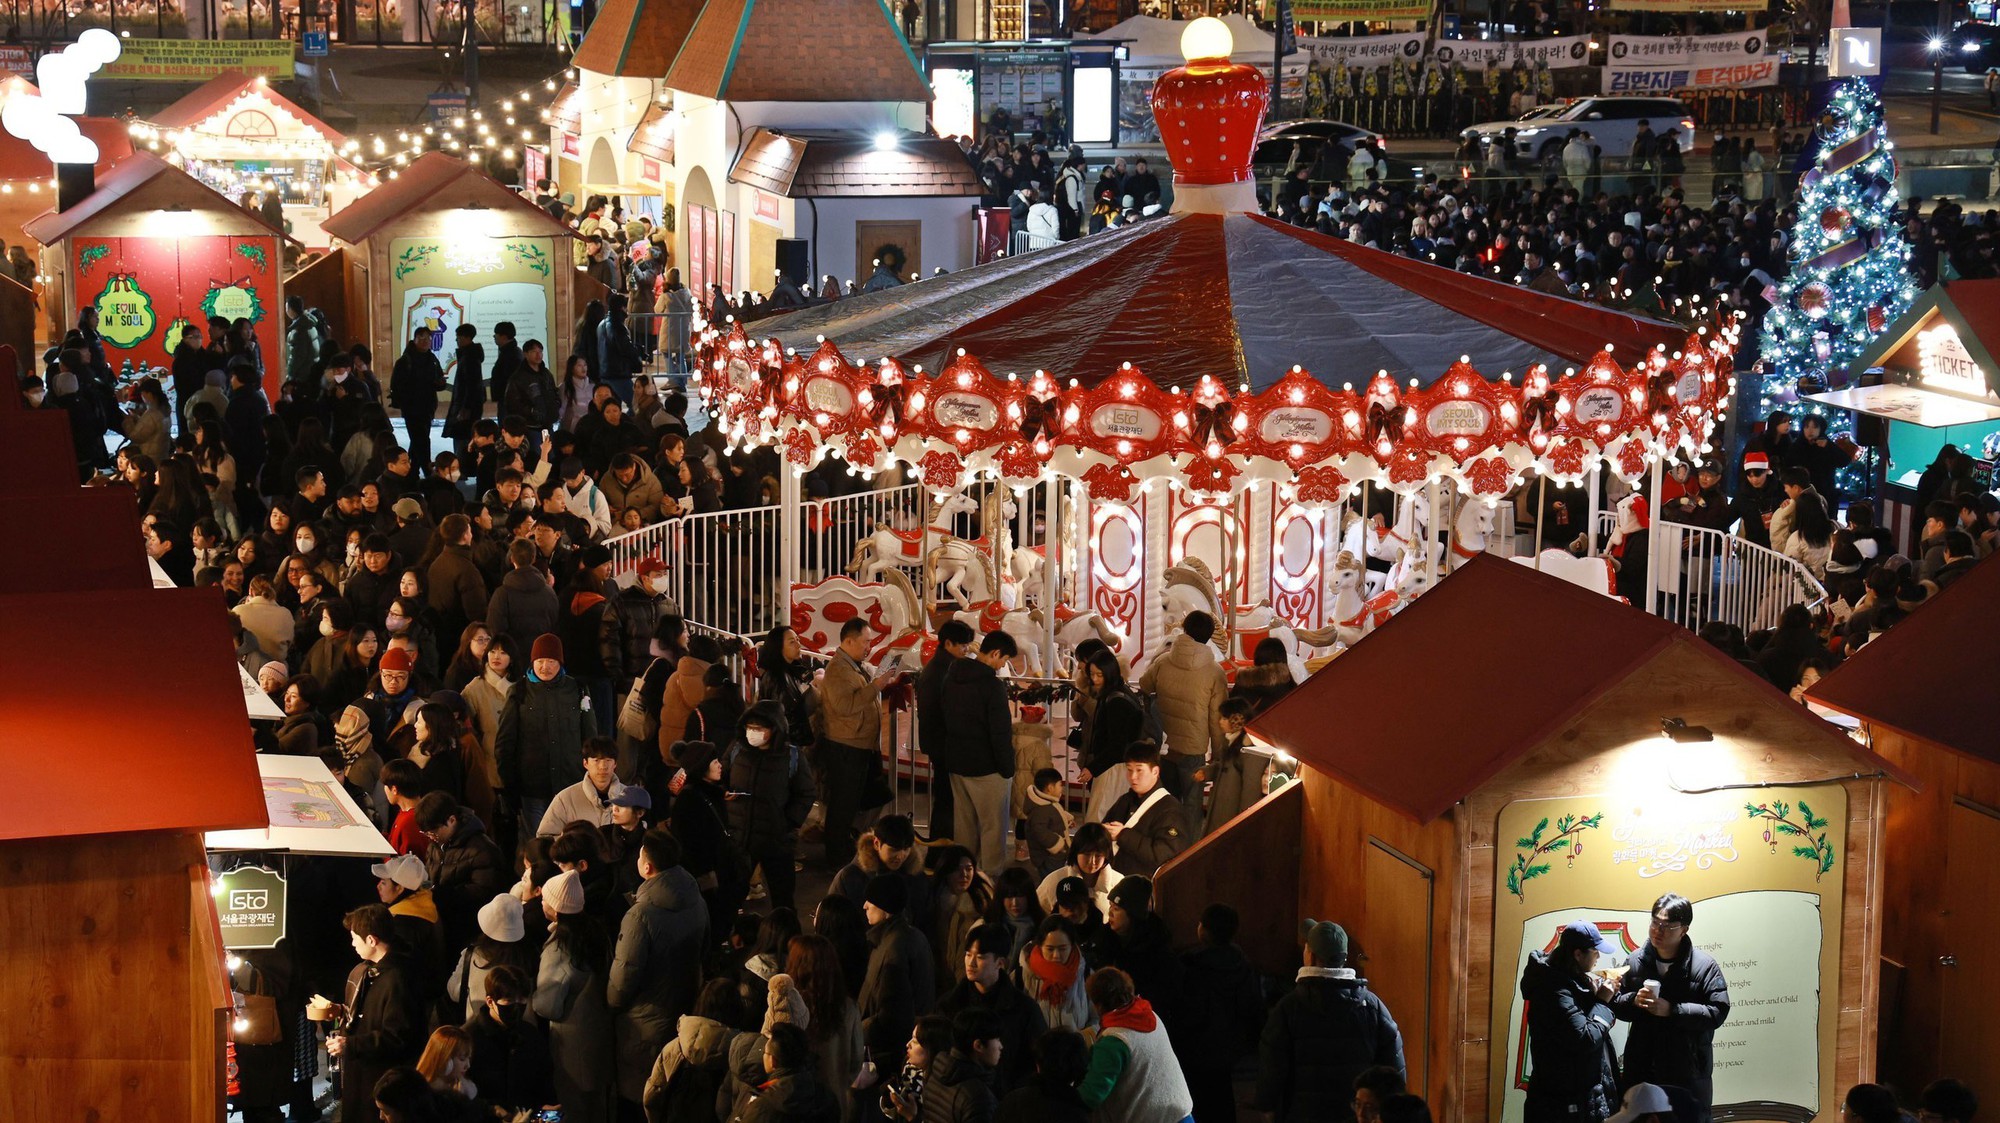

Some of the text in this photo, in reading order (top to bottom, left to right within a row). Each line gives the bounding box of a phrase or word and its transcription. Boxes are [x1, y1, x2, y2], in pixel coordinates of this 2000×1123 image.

[1843, 36, 1876, 67] N
[1610, 61, 1774, 91] 김현지를 특검하라
[121, 315, 144, 326] SOUL
[1930, 354, 1975, 380] TICKET
[1443, 409, 1475, 418] SEOUL
[230, 889, 269, 910] std
[221, 913, 276, 924] 서울관광재단
[1722, 960, 1758, 970] holy night
[1730, 979, 1752, 989] bright
[1766, 996, 1780, 1004] and
[1780, 995, 1799, 1003] Child
[1745, 1018, 1759, 1026] and
[1760, 1016, 1776, 1025] mild
[1728, 1040, 1747, 1049] peace
[1725, 1060, 1745, 1069] peace
